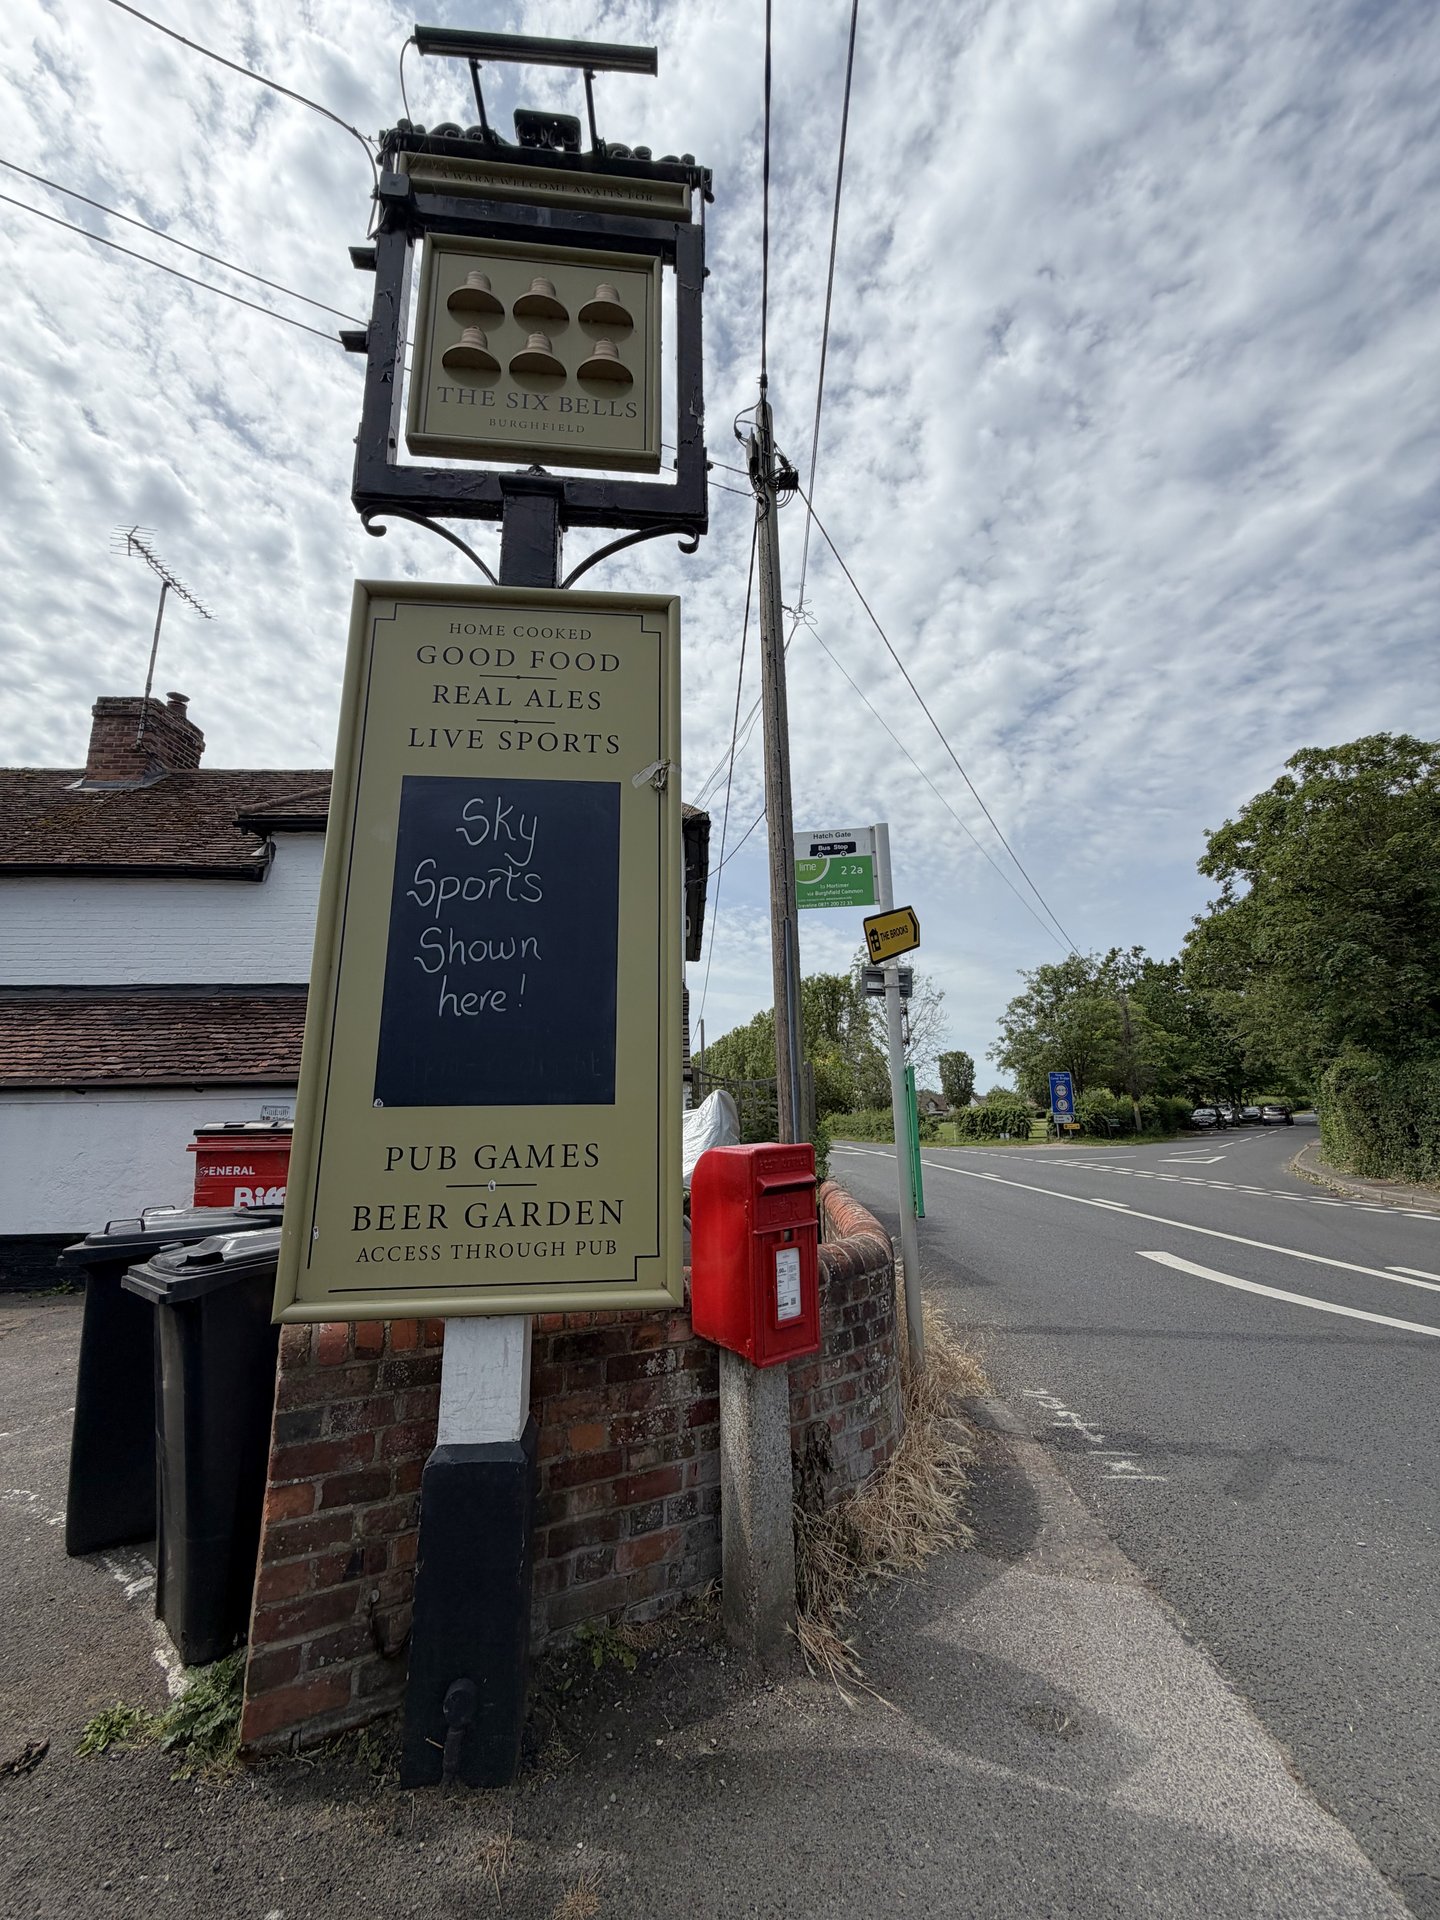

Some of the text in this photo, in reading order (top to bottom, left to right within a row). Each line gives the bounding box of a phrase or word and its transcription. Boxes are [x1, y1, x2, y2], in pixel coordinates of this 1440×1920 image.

[452, 171, 495, 184] WARM
[499, 177, 567, 192] WELCOME
[574, 186, 623, 199] AWAITS
[437, 386, 638, 419] THE SIX BELLS
[489, 418, 586, 434] BURGHFIELD
[449, 623, 592, 641] HOME COOKED
[416, 645, 621, 672] GOOD FOOD
[432, 684, 601, 710] REAL ALES
[408, 727, 620, 755] LIVE SPORTS
[456, 796, 538, 866] Sky
[841, 865, 863, 875] 2 2a
[407, 858, 543, 919] Sports
[880, 925, 909, 942] THE BROOKS
[414, 927, 542, 973] Shown
[384, 1142, 600, 1171] PUB GAMES
[200, 1166, 256, 1176] GENERAL
[351, 1199, 625, 1231] BEER GARDEN
[356, 1239, 617, 1263] ACCESS THROUGH PUB
